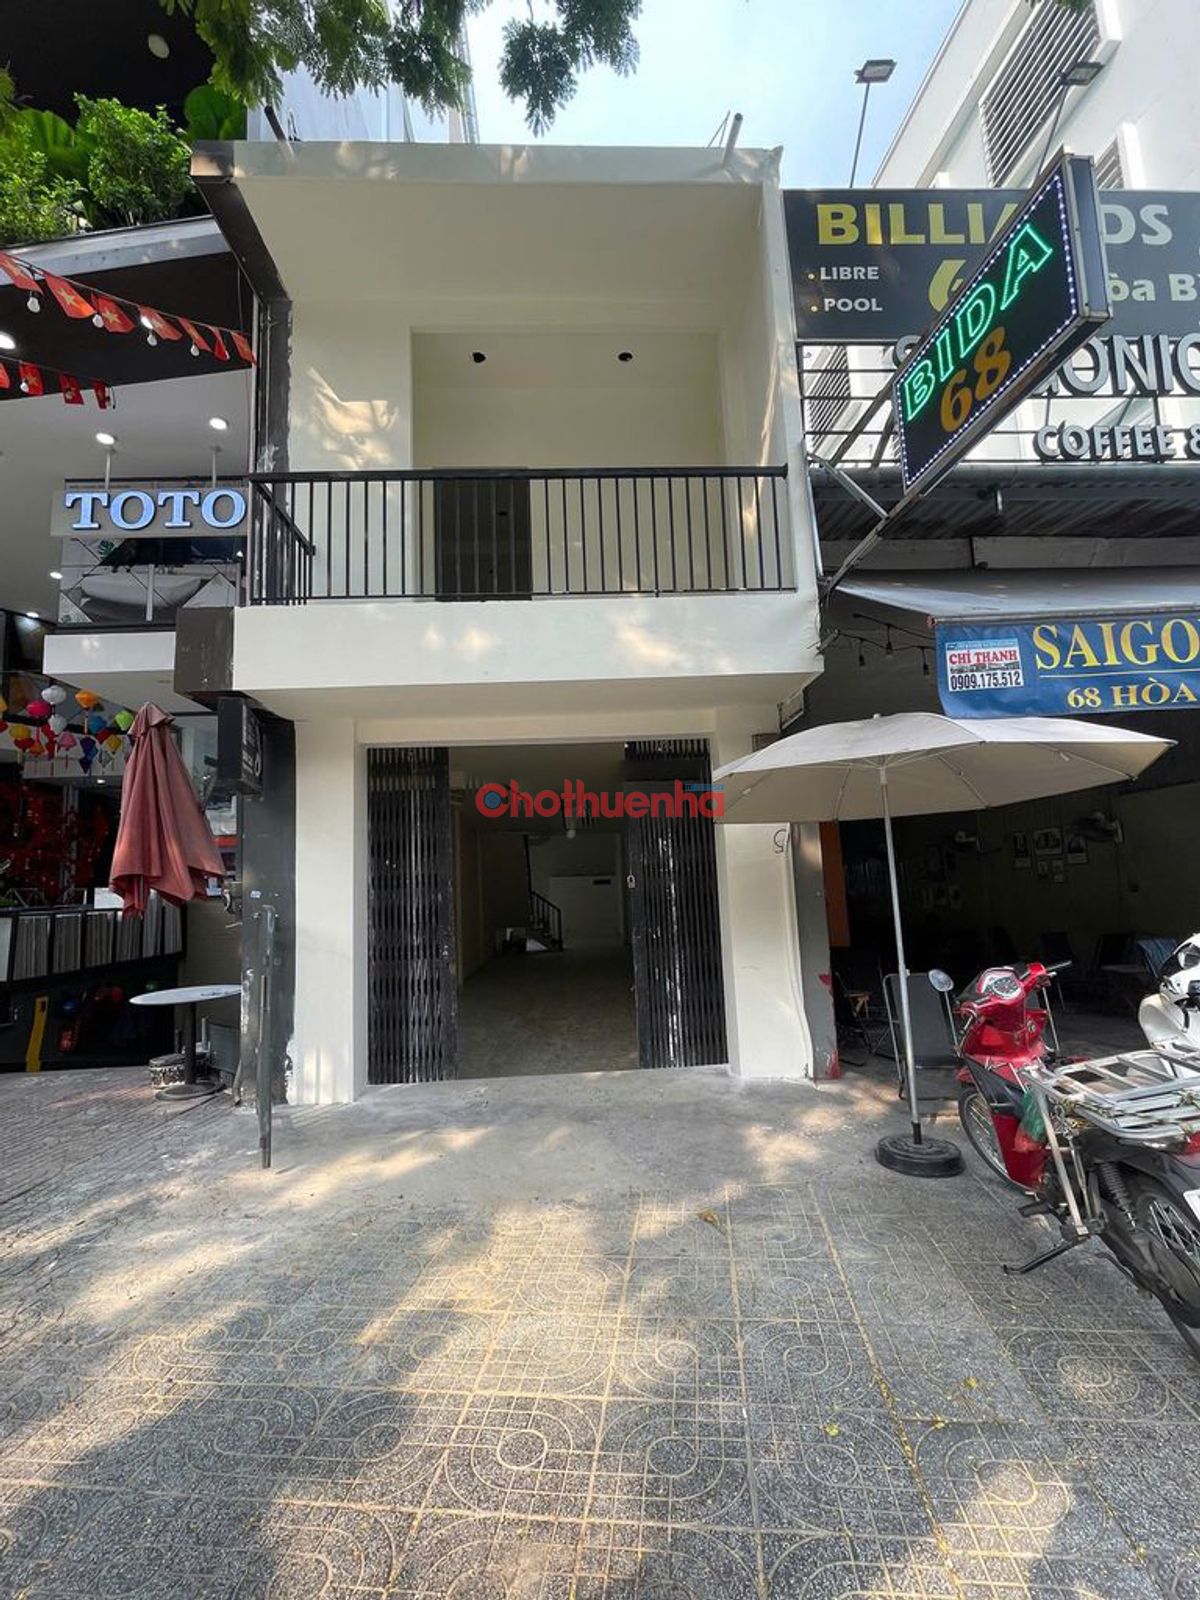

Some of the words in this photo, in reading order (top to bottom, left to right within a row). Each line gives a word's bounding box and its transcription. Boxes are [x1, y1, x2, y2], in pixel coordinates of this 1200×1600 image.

[816, 203, 1173, 246] BILLIDS
[820, 266, 880, 280] LIBRE
[823, 298, 883, 312] POOL
[904, 223, 1054, 421] BIDA
[940, 326, 1011, 432] 68
[1036, 424, 1176, 457] COFFEE
[64, 489, 247, 531] TOTO
[975, 650, 1018, 663] THANH
[1032, 618, 1200, 670] SAIGO
[950, 670, 1021, 690] 0909.175.512
[1067, 687, 1102, 708] 68
[1110, 677, 1198, 706] HÒA
